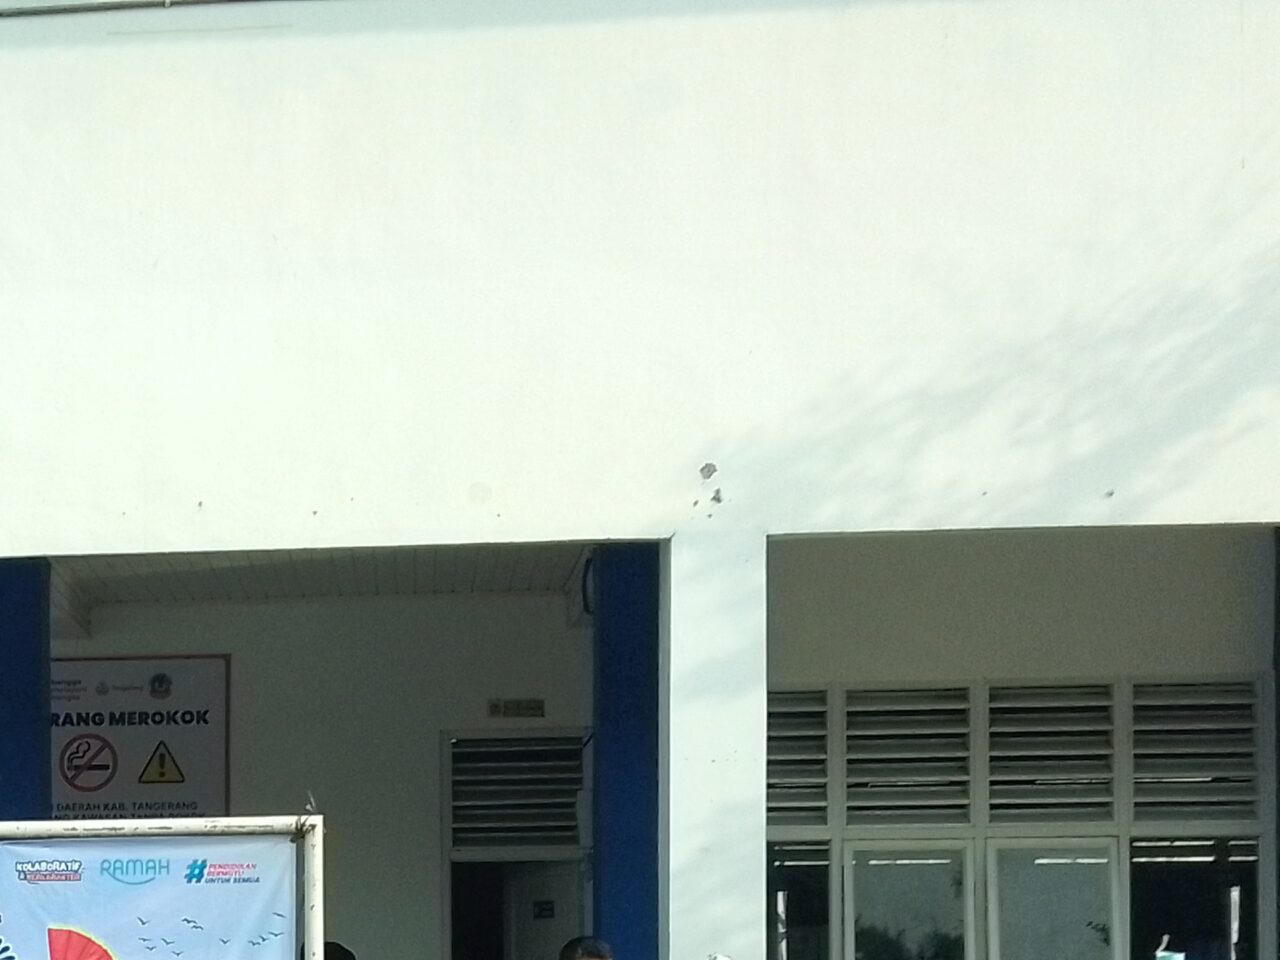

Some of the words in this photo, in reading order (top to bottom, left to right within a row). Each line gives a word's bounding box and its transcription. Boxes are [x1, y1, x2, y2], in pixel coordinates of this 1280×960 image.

[109, 710, 210, 726] MEROKOK
[57, 803, 100, 811] DAERAH
[132, 801, 198, 810] TANGERANG
[100, 858, 170, 877] RAMAH
